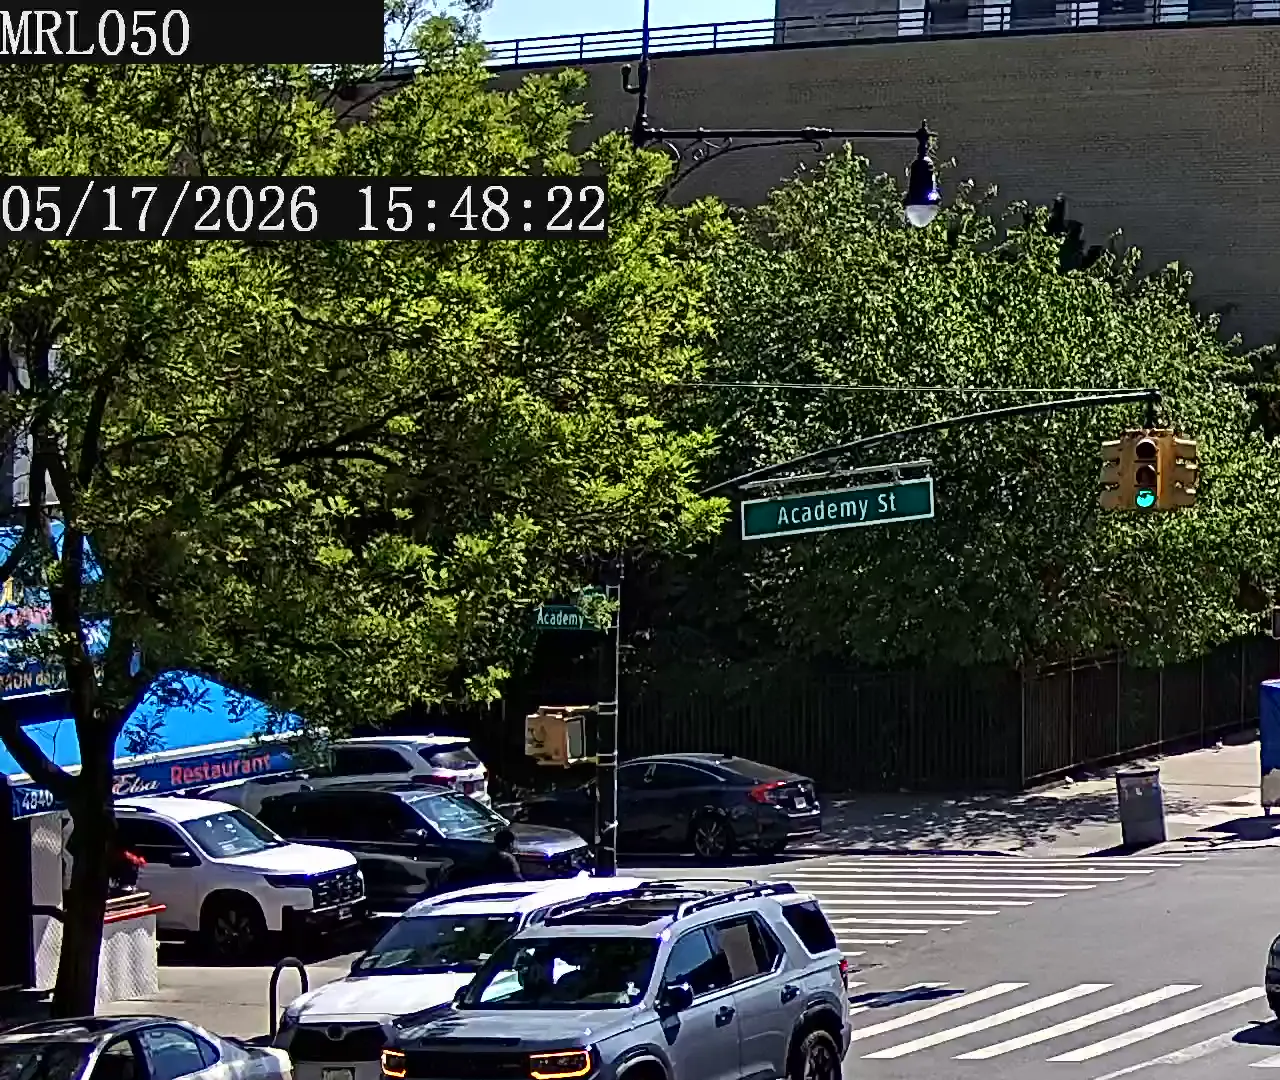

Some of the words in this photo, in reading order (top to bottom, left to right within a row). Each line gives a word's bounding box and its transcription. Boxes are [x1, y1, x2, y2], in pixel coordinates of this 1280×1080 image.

[777, 500, 868, 525] Academy
[878, 491, 896, 512] St
[537, 606, 584, 629] Academy
[170, 752, 271, 786] Restaurant
